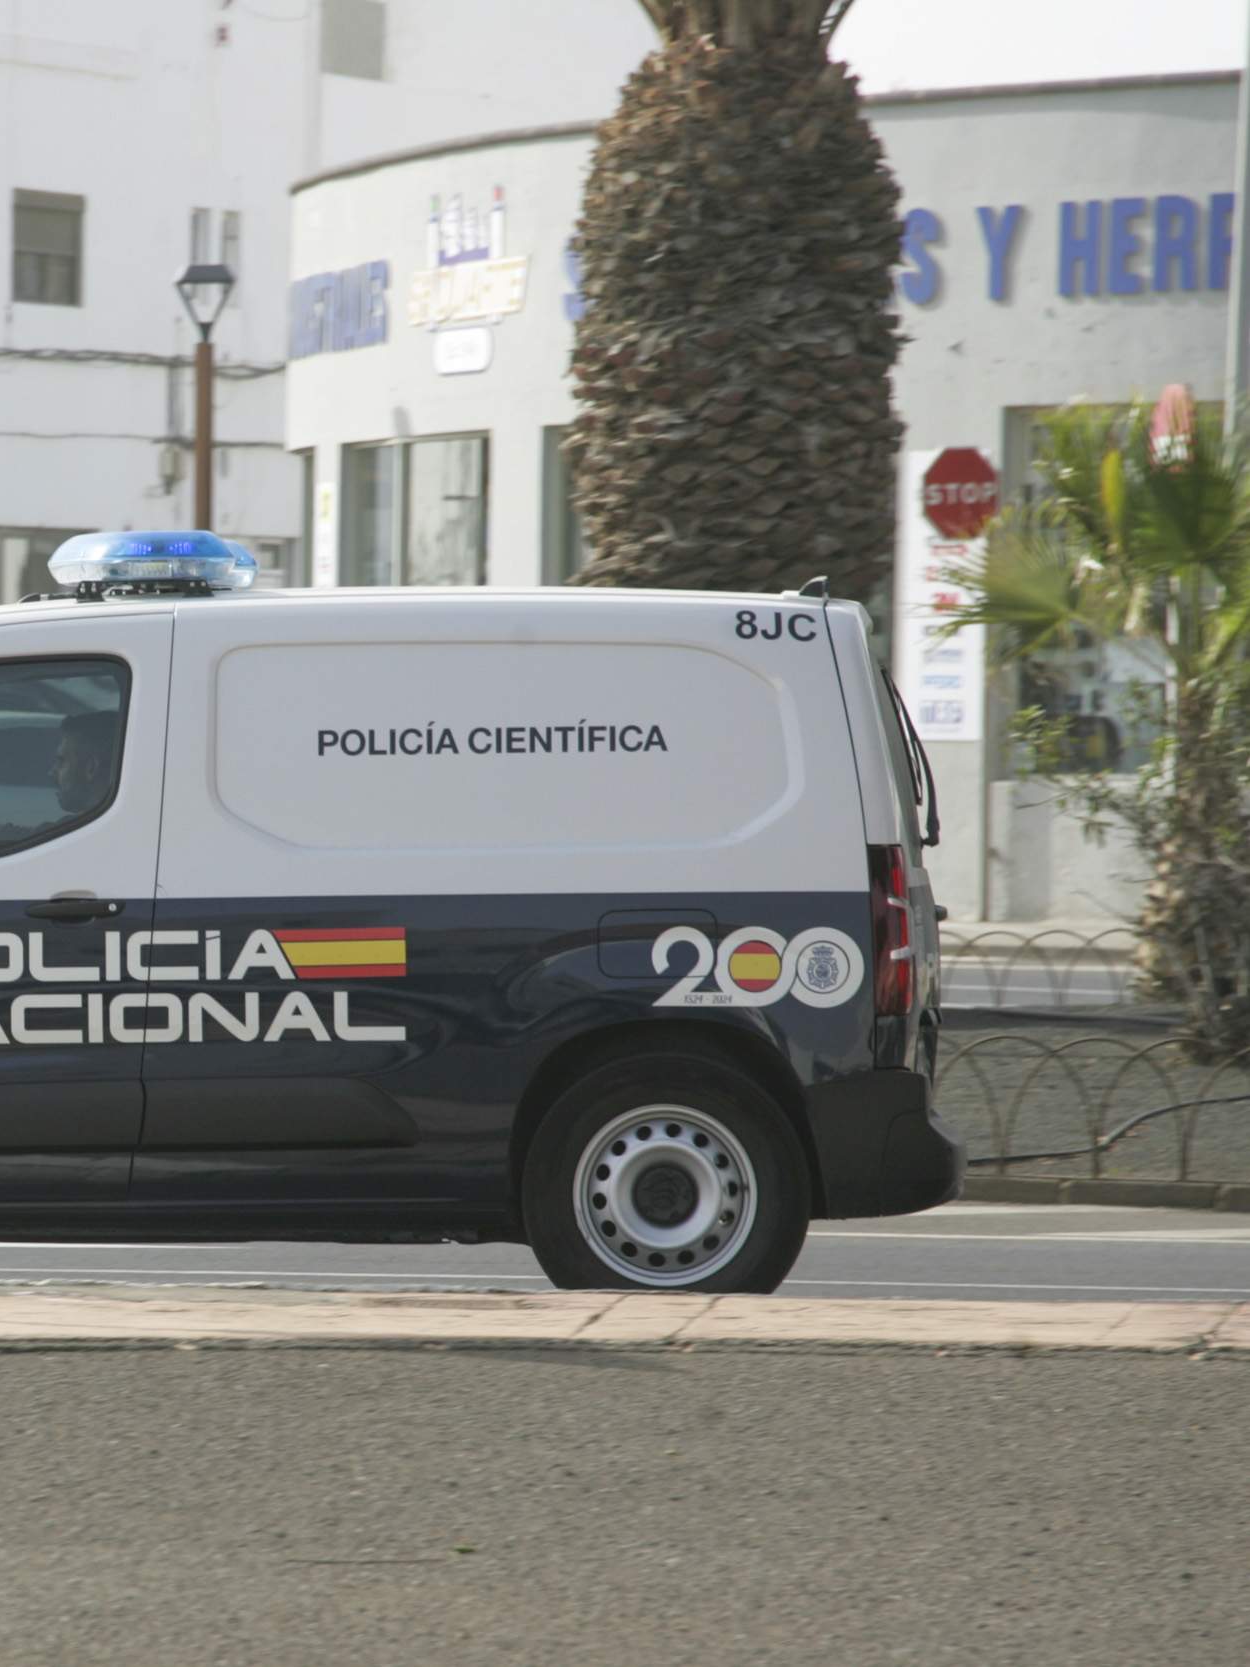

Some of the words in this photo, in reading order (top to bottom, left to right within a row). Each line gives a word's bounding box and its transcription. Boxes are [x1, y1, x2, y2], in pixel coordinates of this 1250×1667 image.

[975, 205, 1024, 301] Y
[925, 482, 998, 505] STOP
[735, 610, 817, 641] 8JC
[317, 720, 460, 757] POLICÍA
[467, 719, 669, 754] CIENTÍFICA
